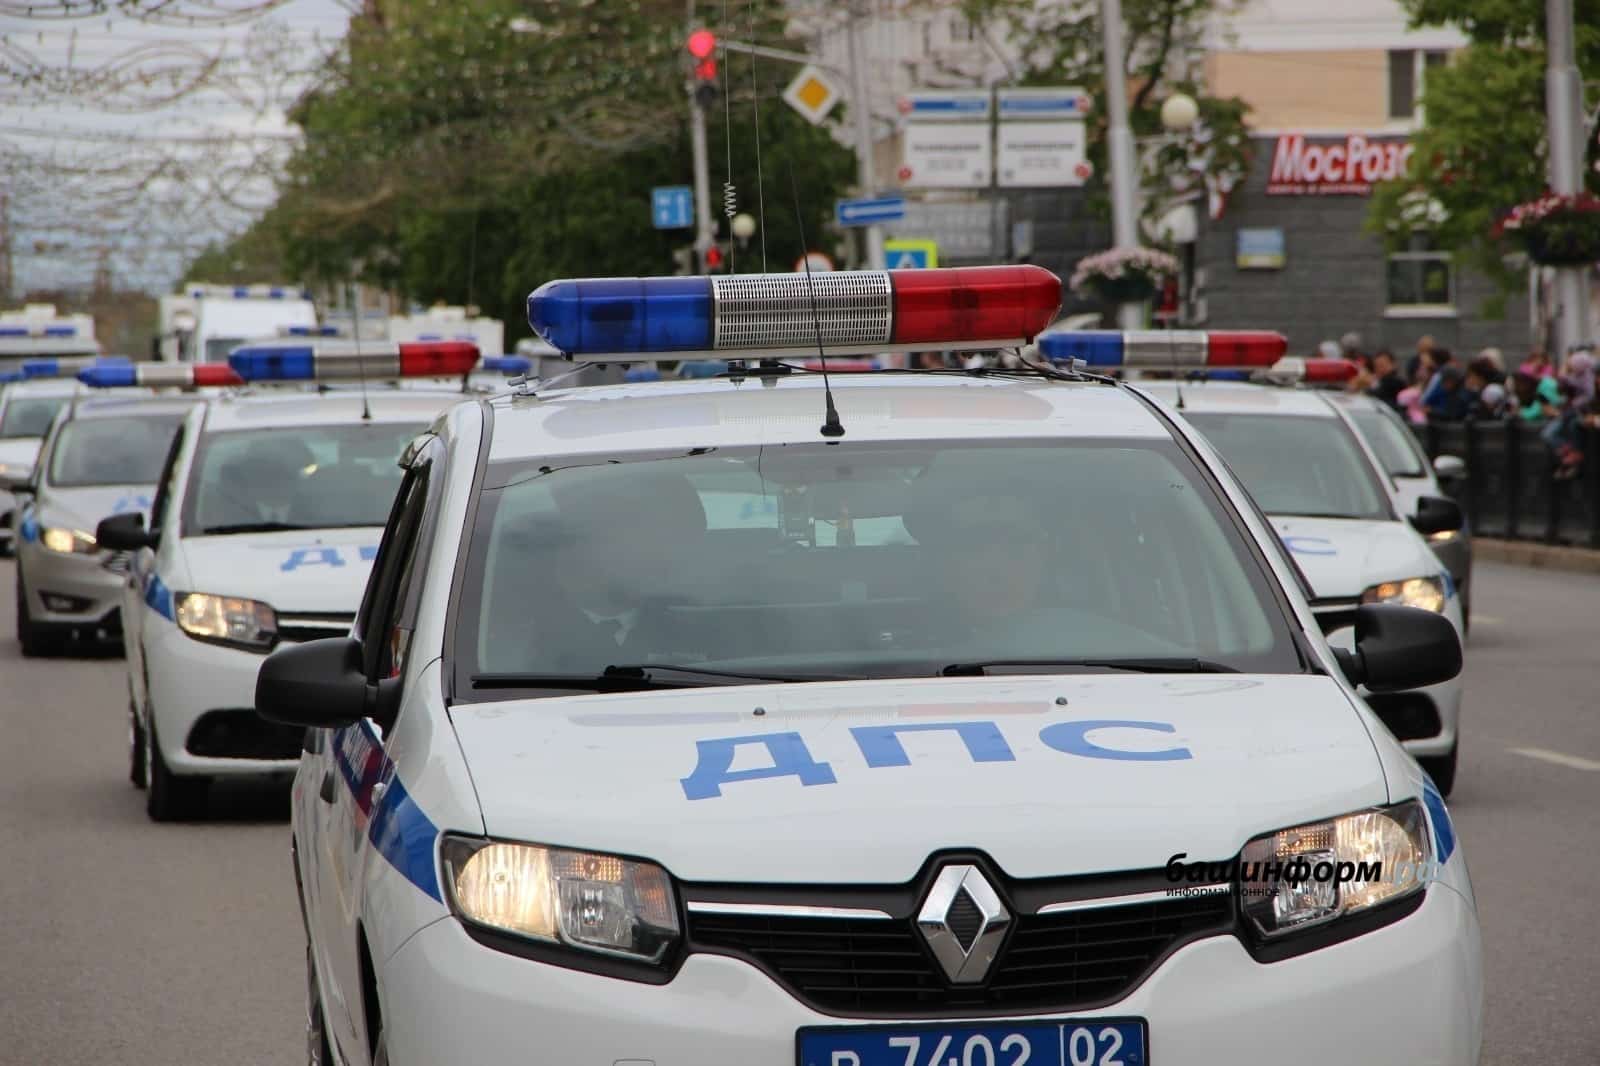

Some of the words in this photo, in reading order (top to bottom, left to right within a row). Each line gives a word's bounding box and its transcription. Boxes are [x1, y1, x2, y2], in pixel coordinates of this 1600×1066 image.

[280, 547, 377, 571] Д
[680, 720, 1193, 801] ДПС
[1069, 1027, 1124, 1066] 02
